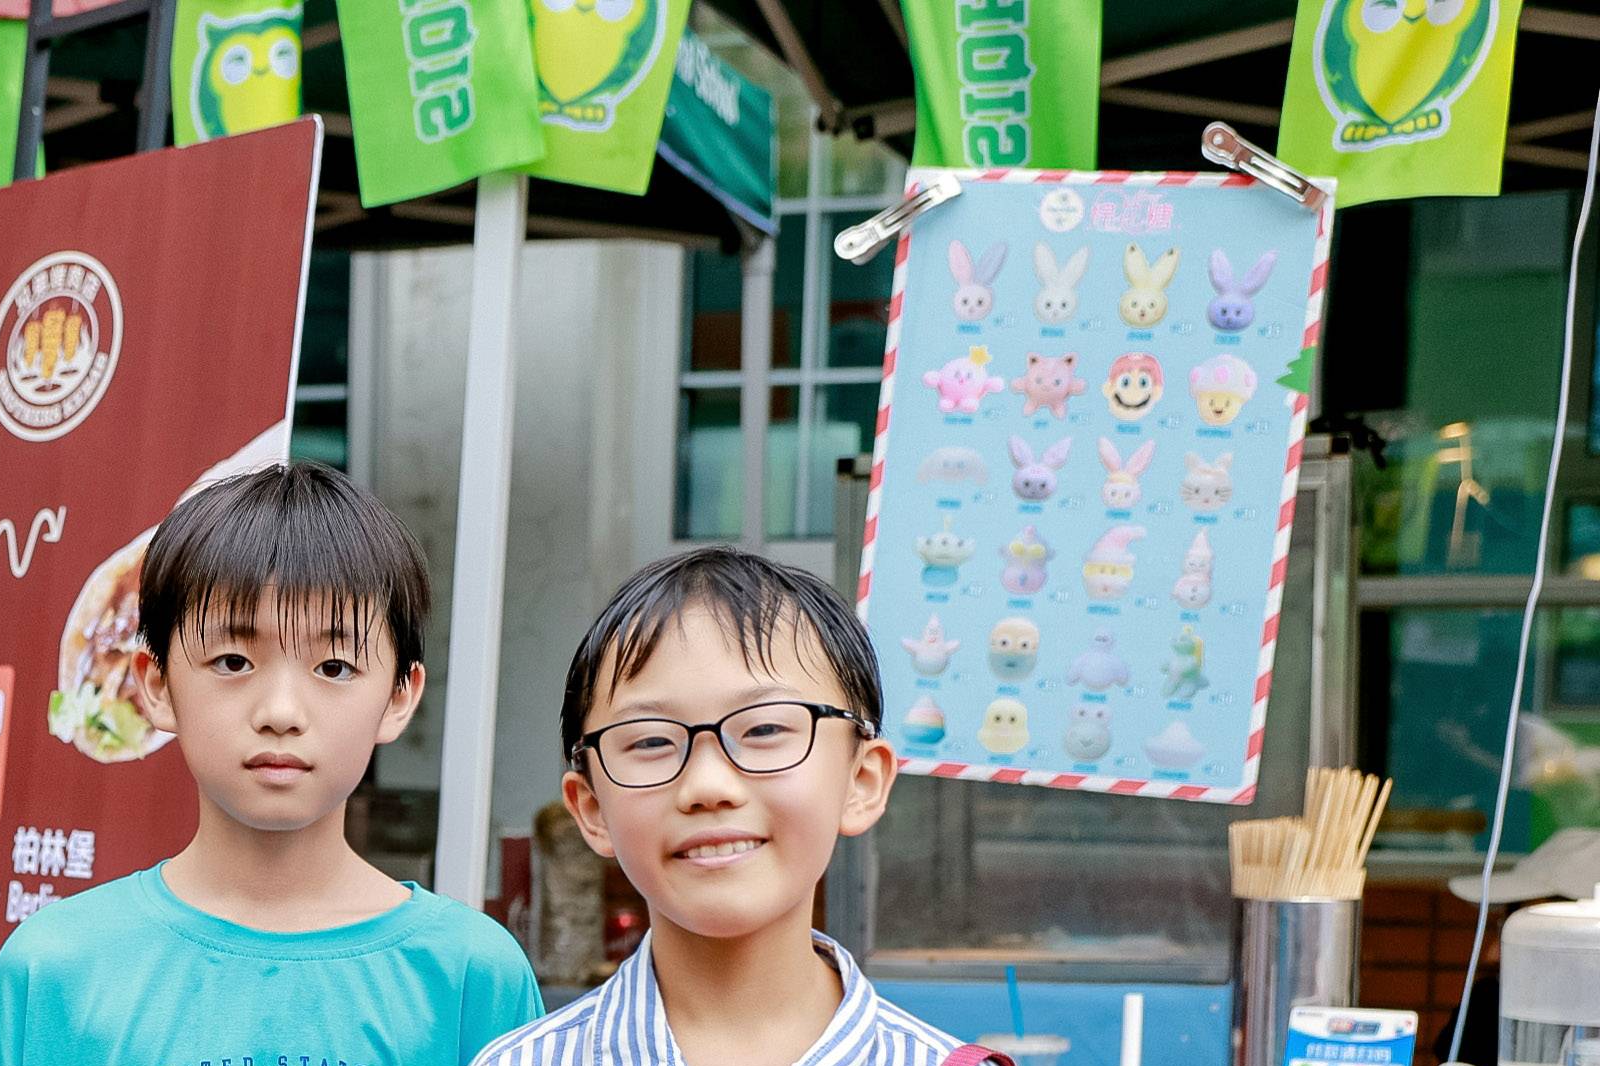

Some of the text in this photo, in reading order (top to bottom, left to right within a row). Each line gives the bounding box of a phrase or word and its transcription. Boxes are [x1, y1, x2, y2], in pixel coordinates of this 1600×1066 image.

[399, 0, 479, 144] QIS
[12, 826, 95, 879] 柏林堡
